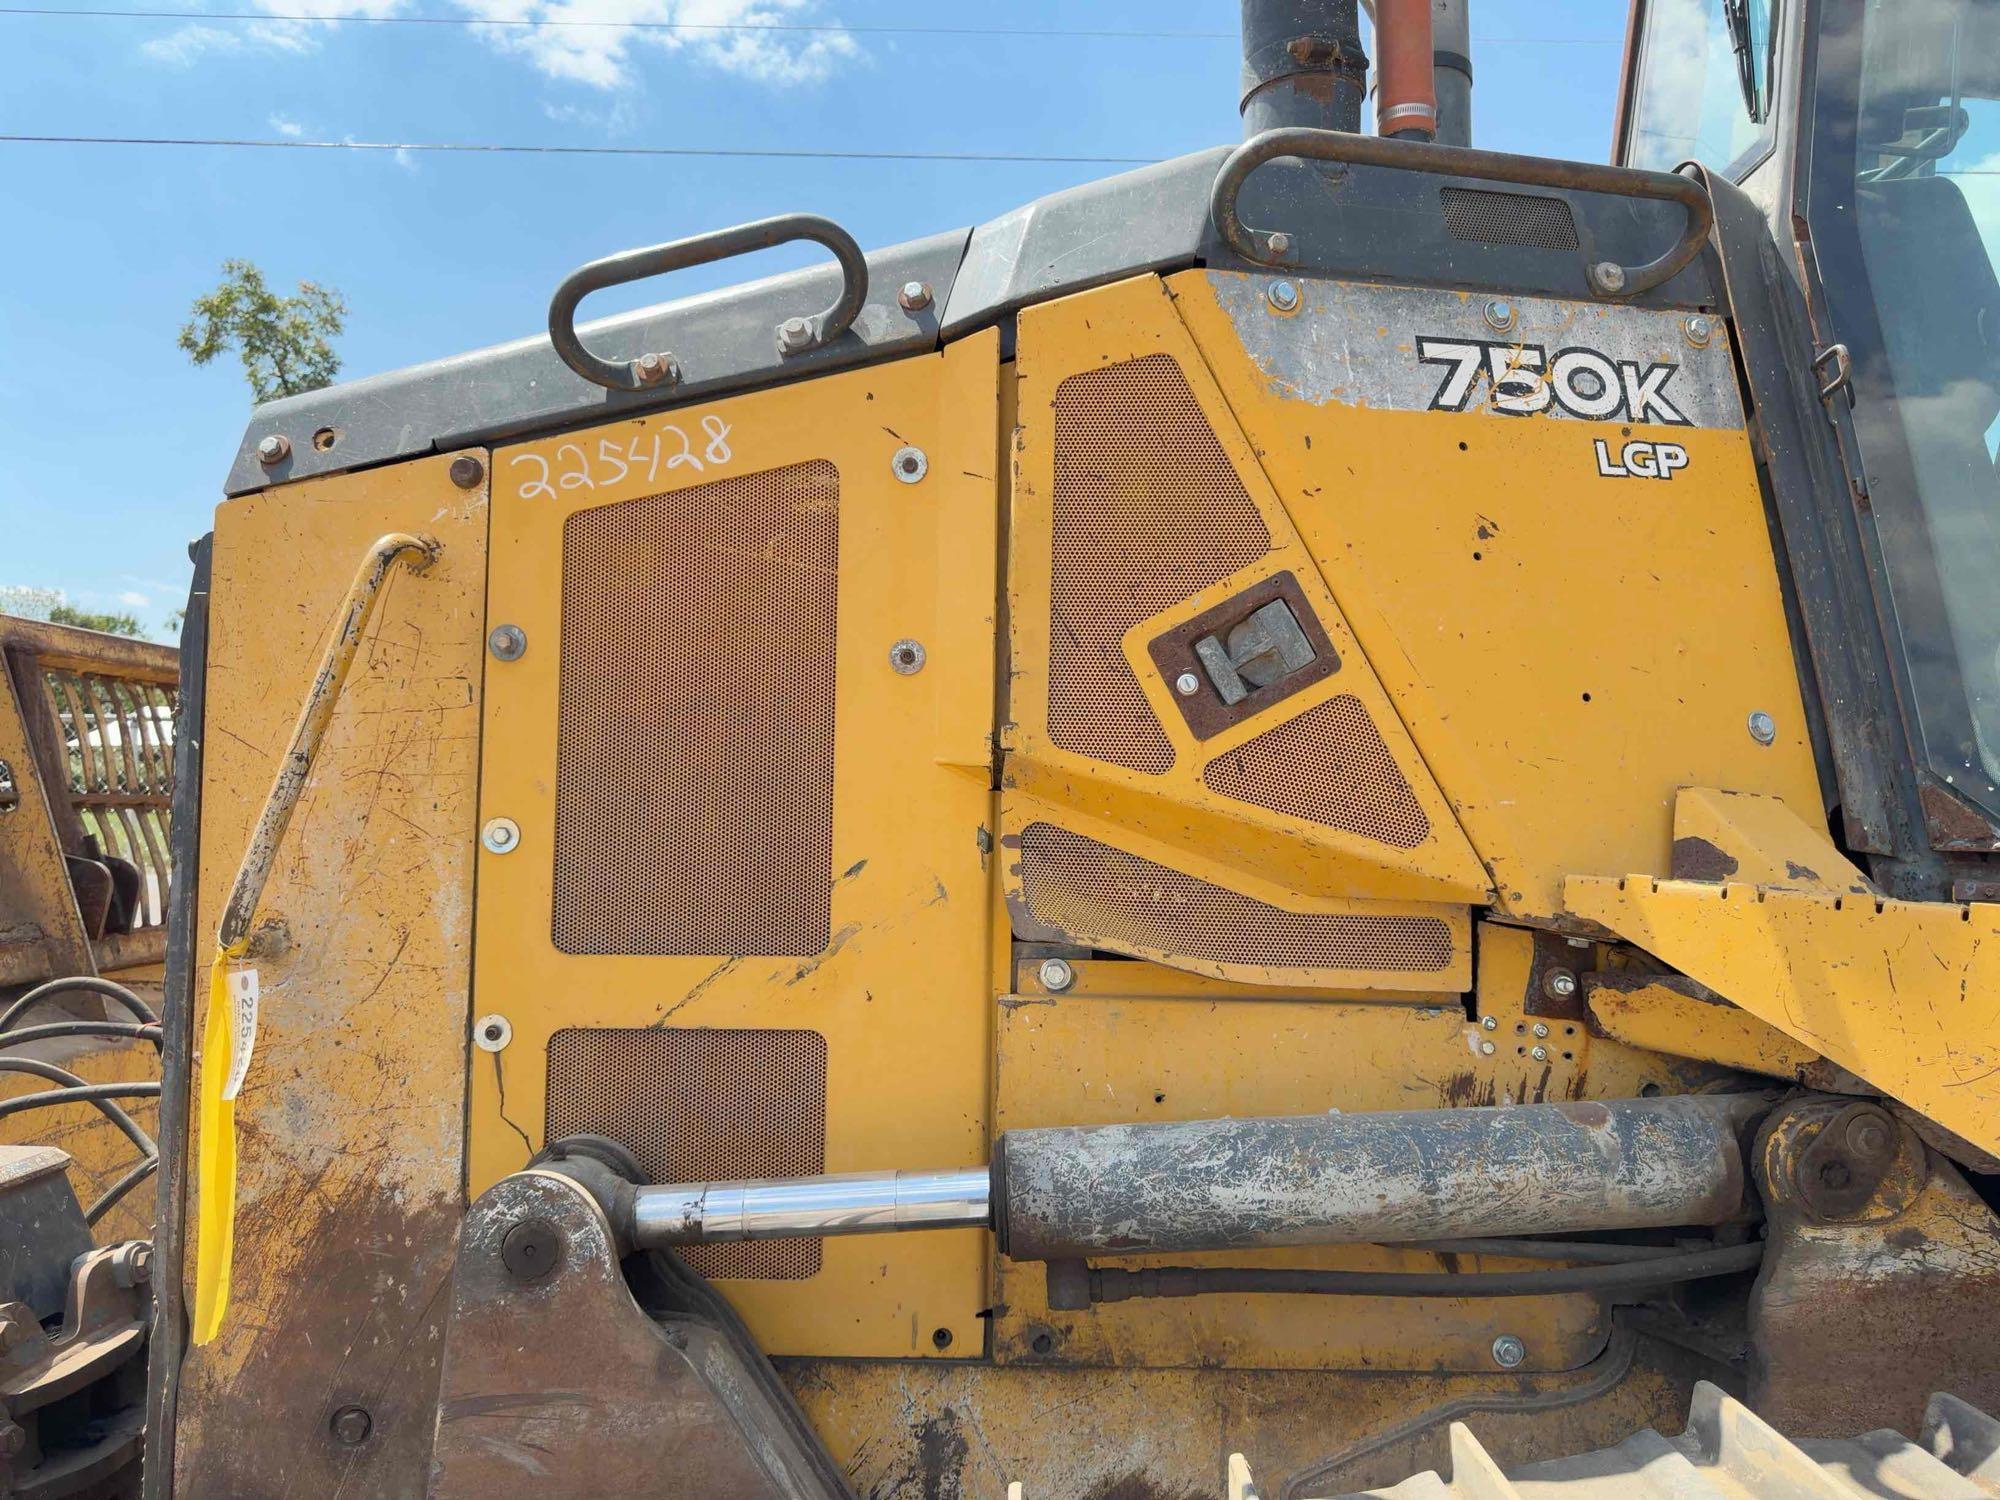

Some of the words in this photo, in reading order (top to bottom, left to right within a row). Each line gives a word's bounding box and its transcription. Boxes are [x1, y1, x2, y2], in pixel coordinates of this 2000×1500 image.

[1415, 335, 1696, 427] 750K
[511, 415, 732, 500] 225428
[1593, 438, 1689, 480] LGP
